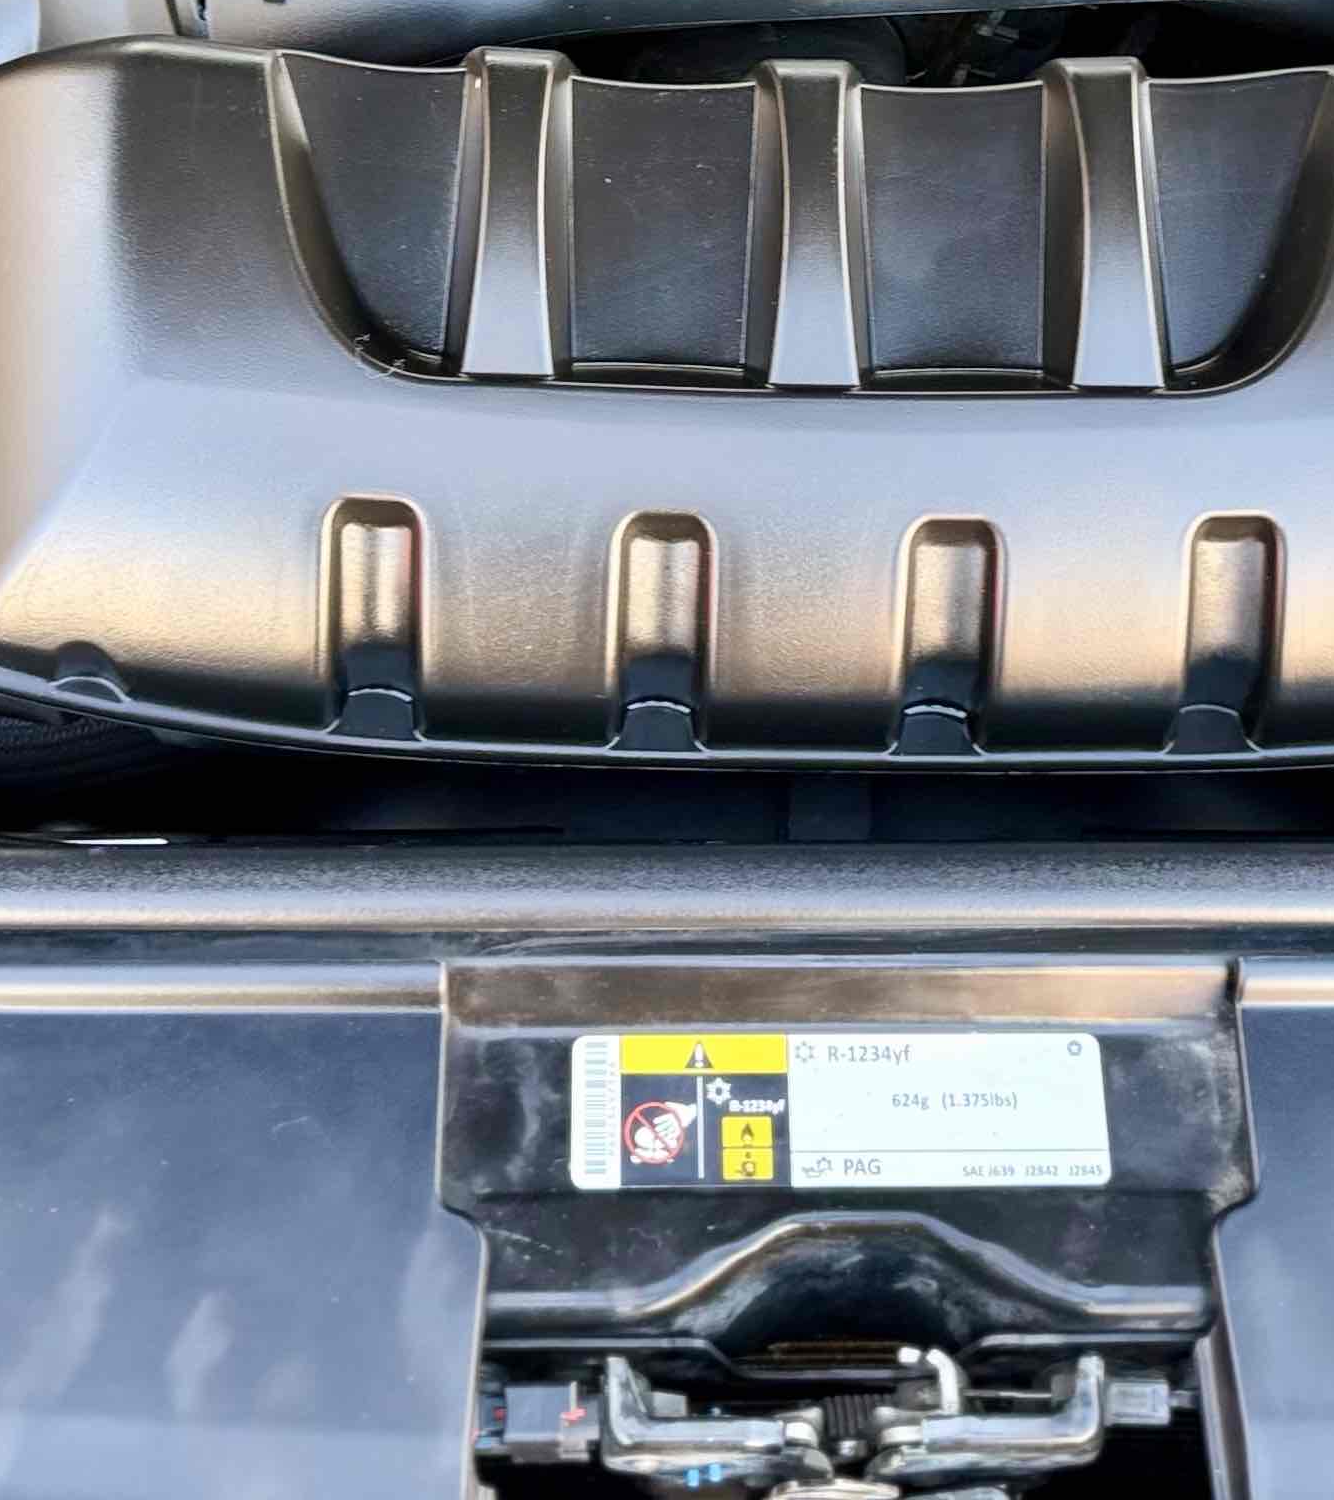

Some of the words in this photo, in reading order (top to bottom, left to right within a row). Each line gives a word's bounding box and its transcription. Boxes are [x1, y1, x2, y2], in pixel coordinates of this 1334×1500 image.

[826, 1043, 911, 1066] R-1234yf
[891, 1093, 931, 1111] 624g
[941, 1092, 1019, 1111] (1.375lbs)
[843, 1158, 882, 1176] PAG
